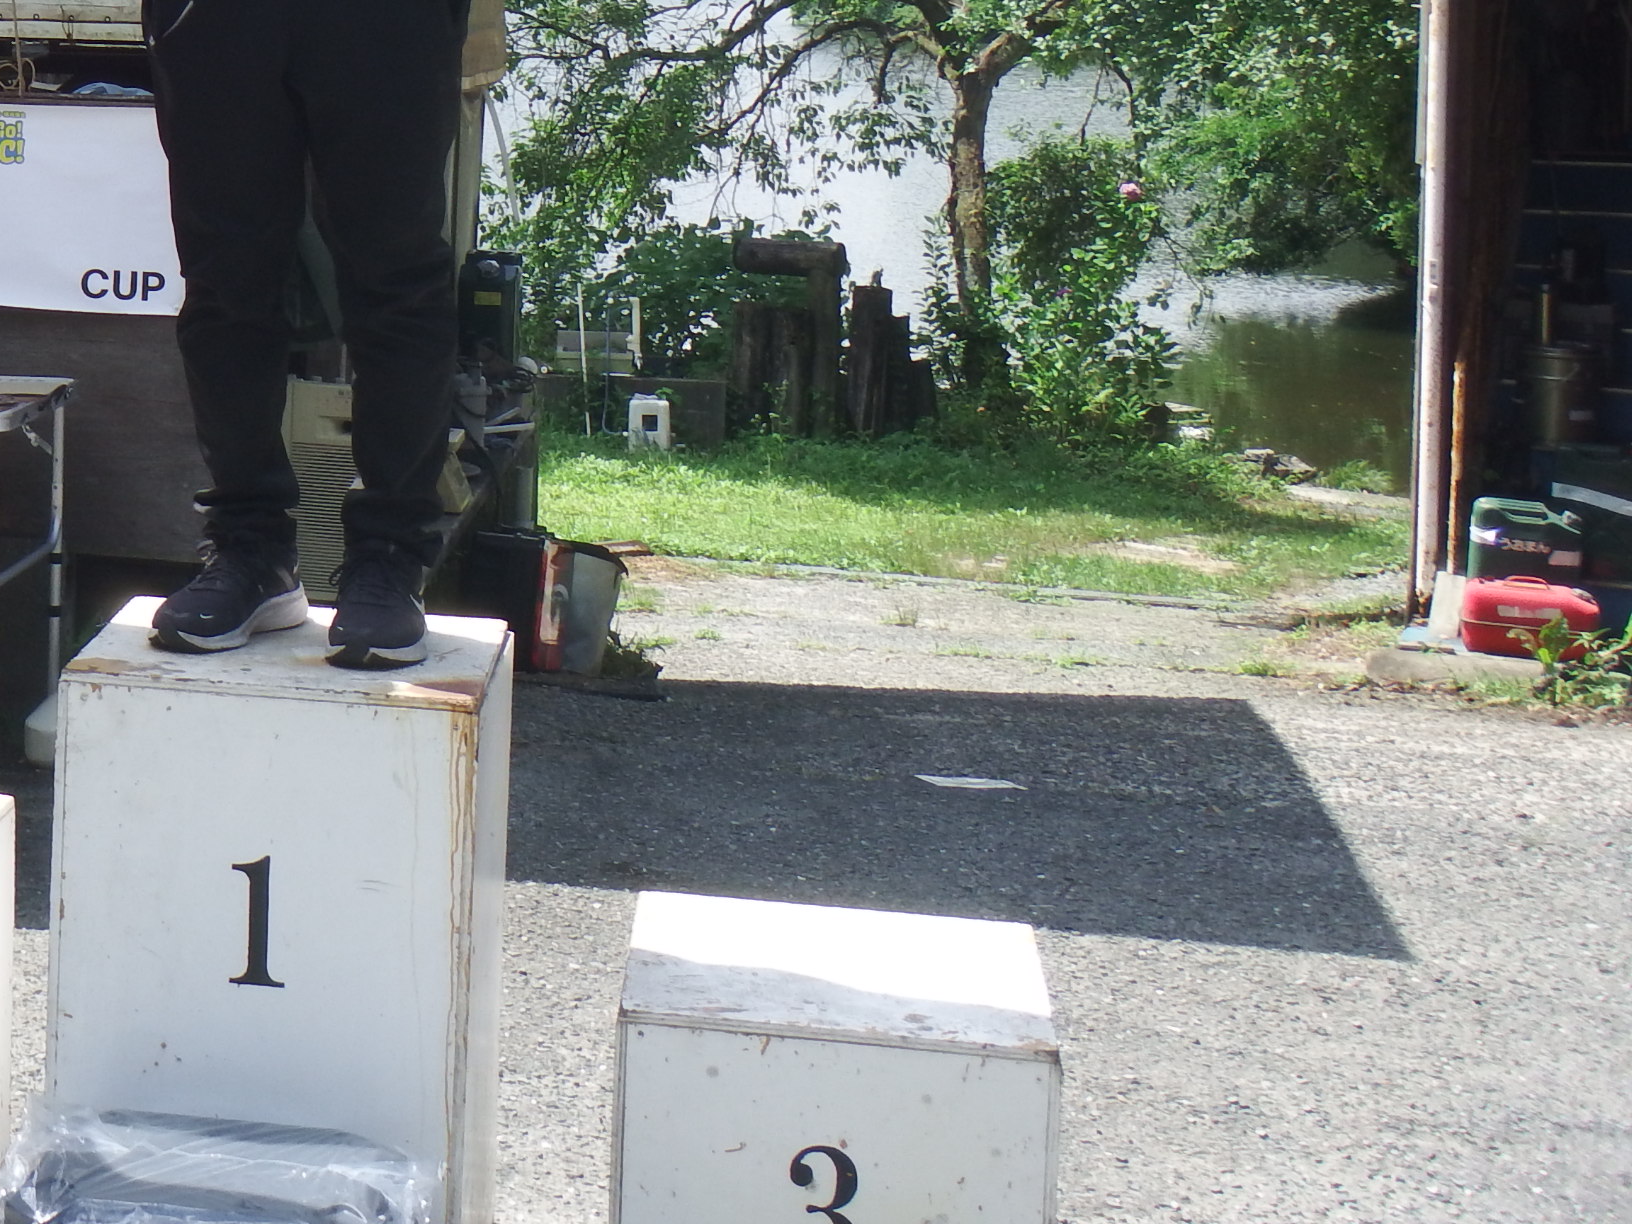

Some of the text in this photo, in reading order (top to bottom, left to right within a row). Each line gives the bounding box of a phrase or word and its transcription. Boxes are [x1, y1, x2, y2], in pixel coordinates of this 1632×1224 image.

[80, 268, 166, 302] CUP
[228, 855, 286, 989] 1
[789, 1145, 858, 1224] 3
